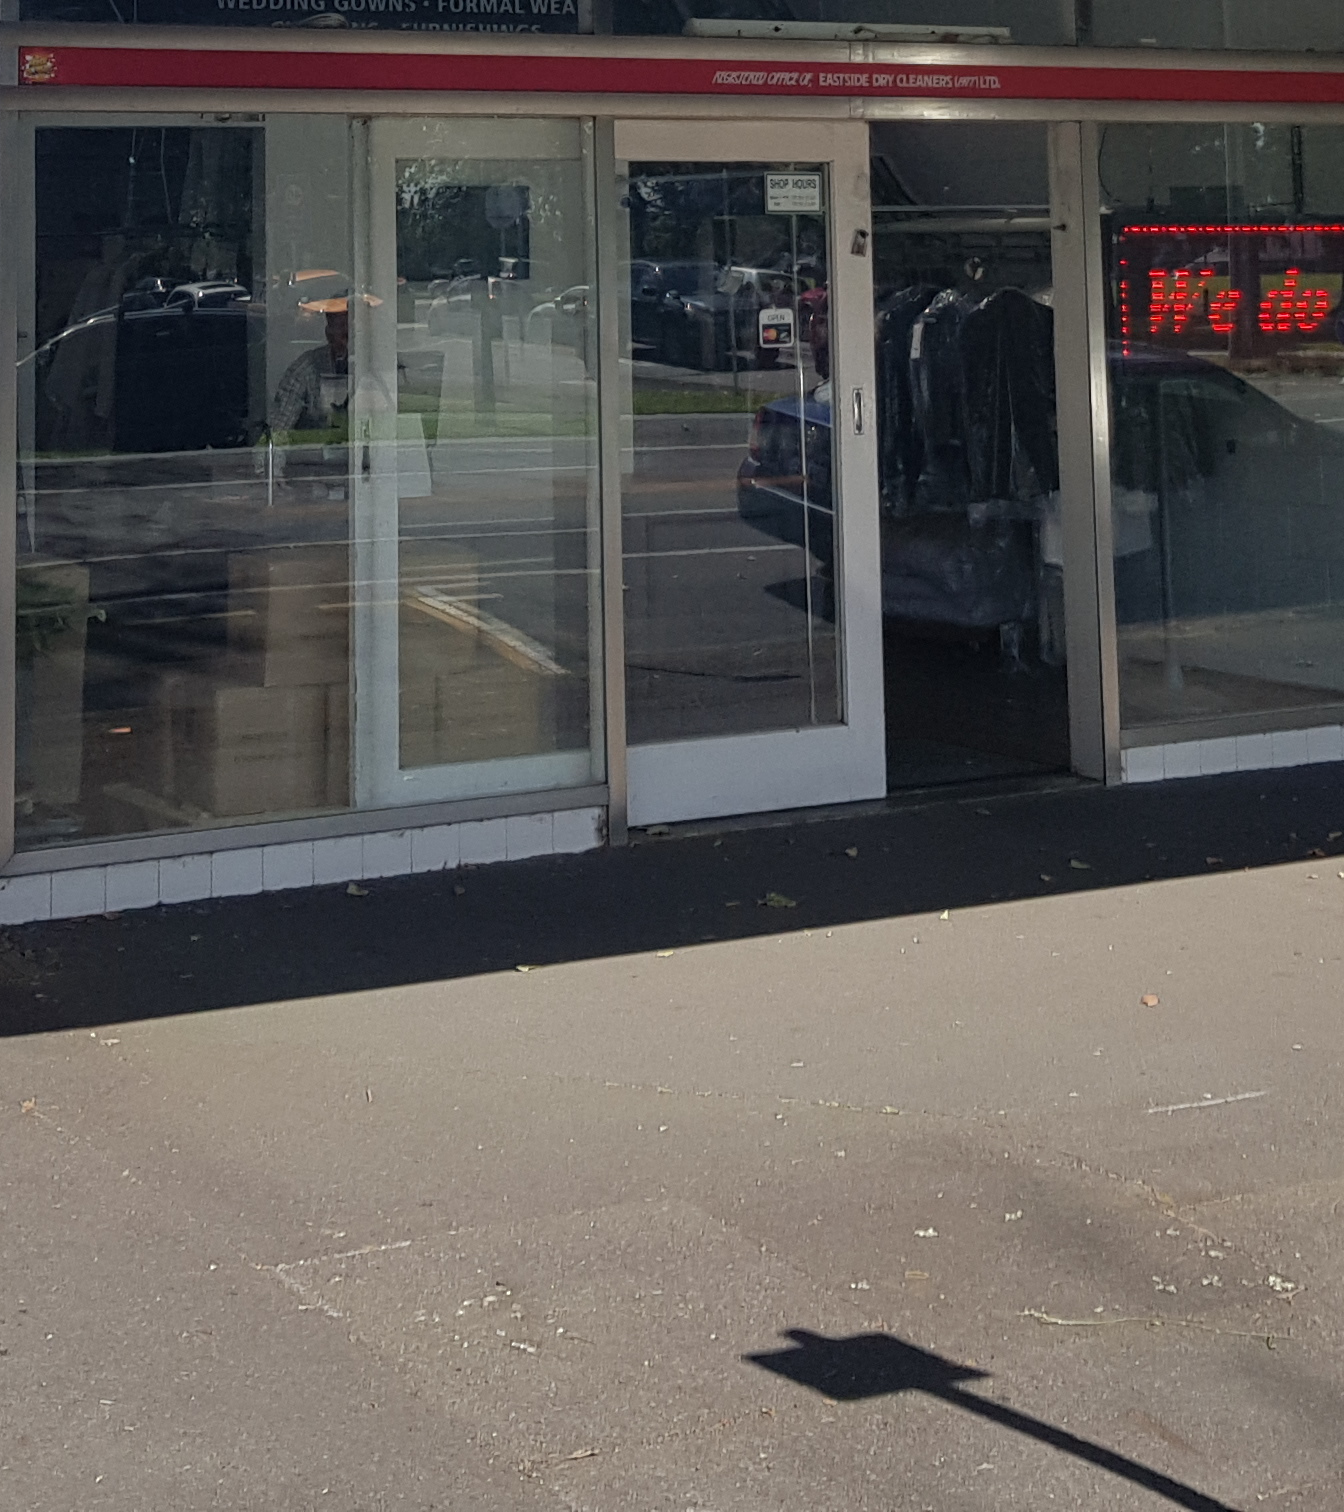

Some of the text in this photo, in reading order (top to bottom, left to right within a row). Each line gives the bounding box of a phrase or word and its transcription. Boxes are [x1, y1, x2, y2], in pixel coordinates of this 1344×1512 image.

[818, 72, 870, 87] EASTSIDE
[872, 73, 894, 87] DRY
[896, 74, 953, 88] CLEANERS
[769, 178, 817, 189] SHOP HOURS
[1258, 267, 1330, 331] do
